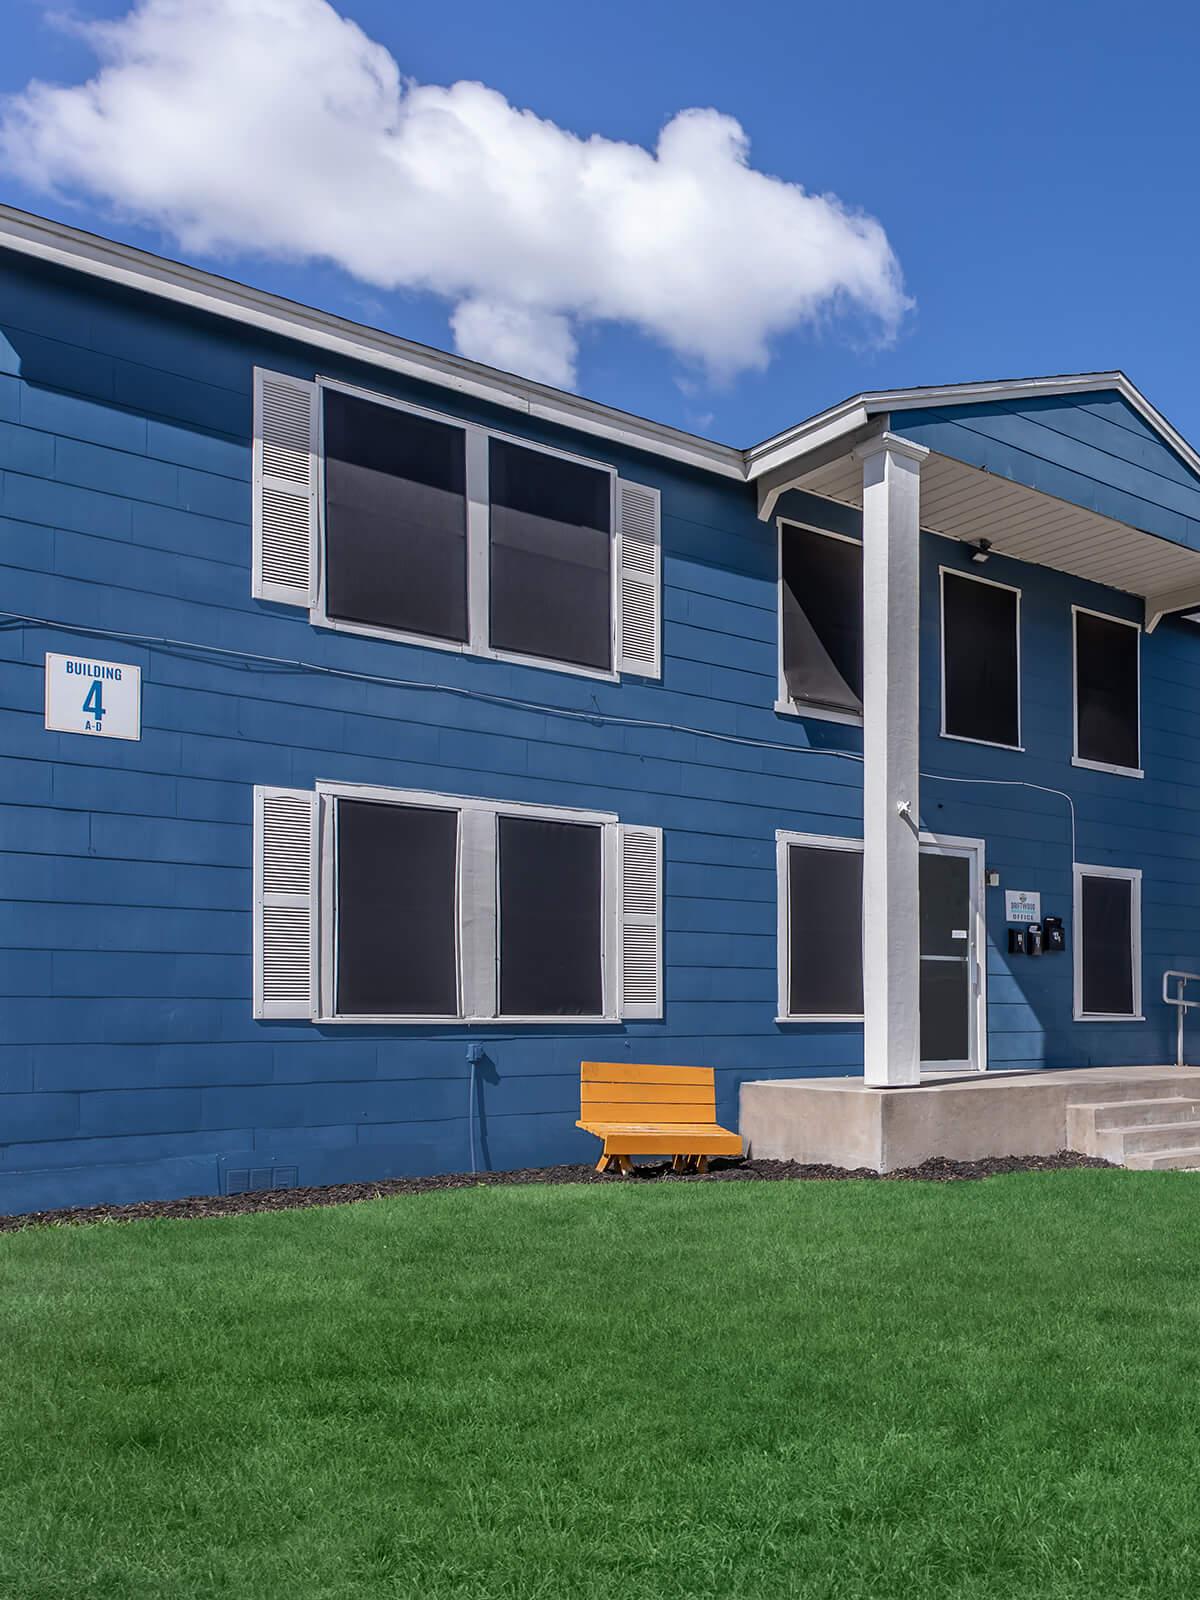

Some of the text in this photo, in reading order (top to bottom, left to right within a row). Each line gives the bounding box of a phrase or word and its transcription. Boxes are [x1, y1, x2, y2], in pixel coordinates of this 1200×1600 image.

[66, 661, 122, 680] BUILDING
[82, 680, 106, 720] 4
[85, 721, 102, 731] A-D
